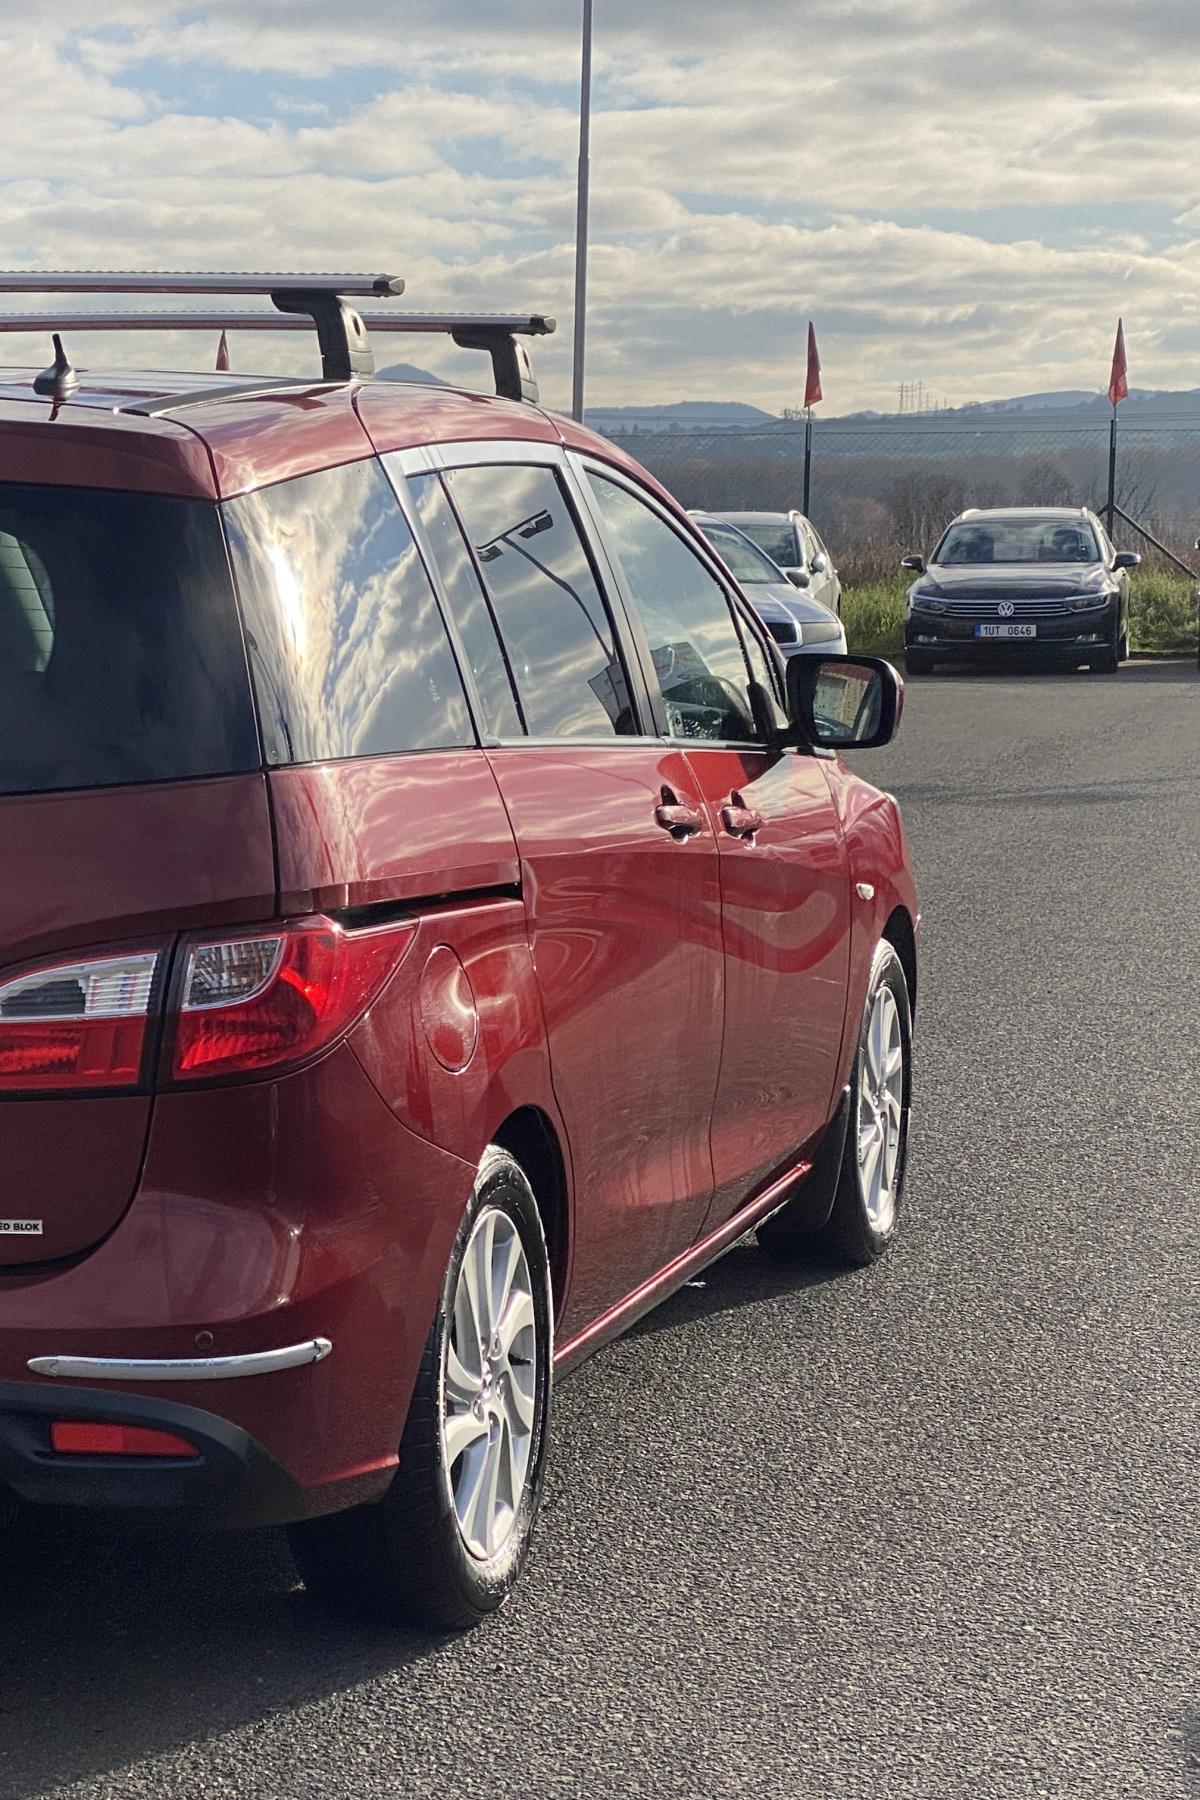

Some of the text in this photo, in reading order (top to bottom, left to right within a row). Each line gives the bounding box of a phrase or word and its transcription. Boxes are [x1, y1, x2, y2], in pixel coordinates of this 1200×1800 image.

[983, 625, 1000, 636] 1UT
[1007, 625, 1032, 636] 0646
[13, 1222, 40, 1231] BLOK
